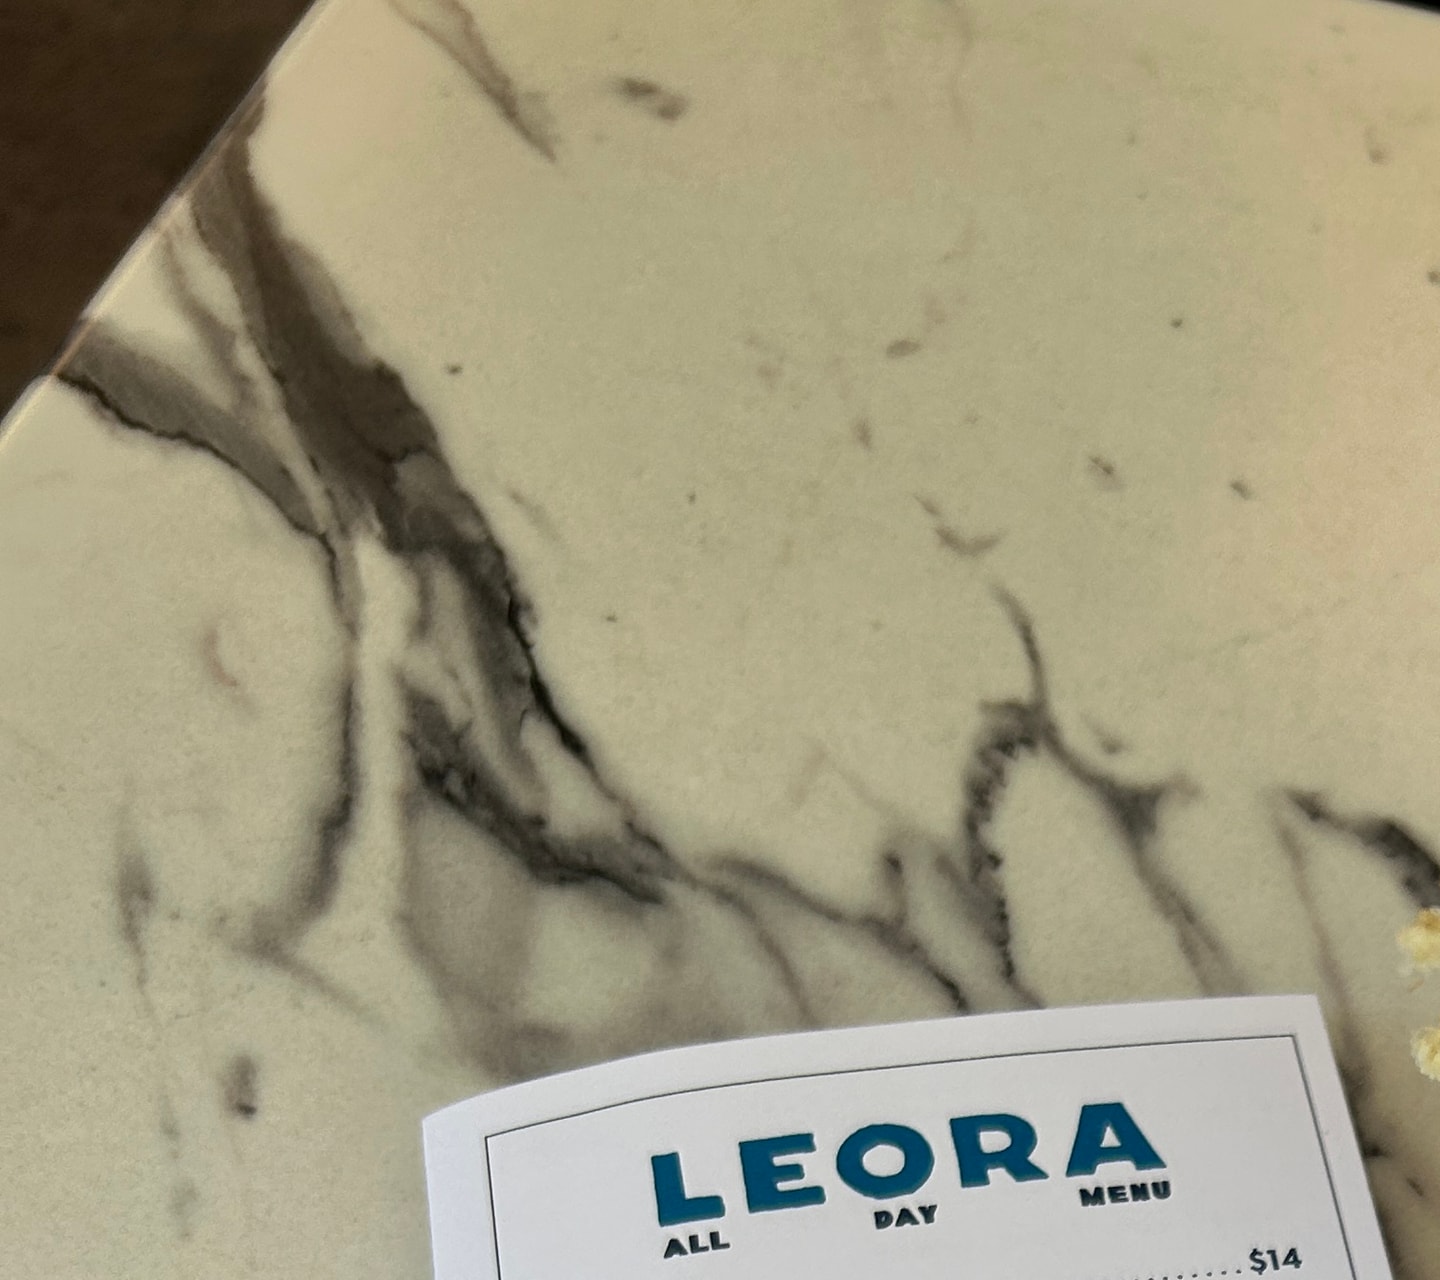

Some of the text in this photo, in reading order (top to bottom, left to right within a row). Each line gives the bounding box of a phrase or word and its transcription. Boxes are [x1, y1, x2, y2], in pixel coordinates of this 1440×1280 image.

[650, 1101, 1167, 1228] LEORA
[663, 1180, 1172, 1260] ALL DAY MENU
[1248, 1247, 1303, 1276] $14
